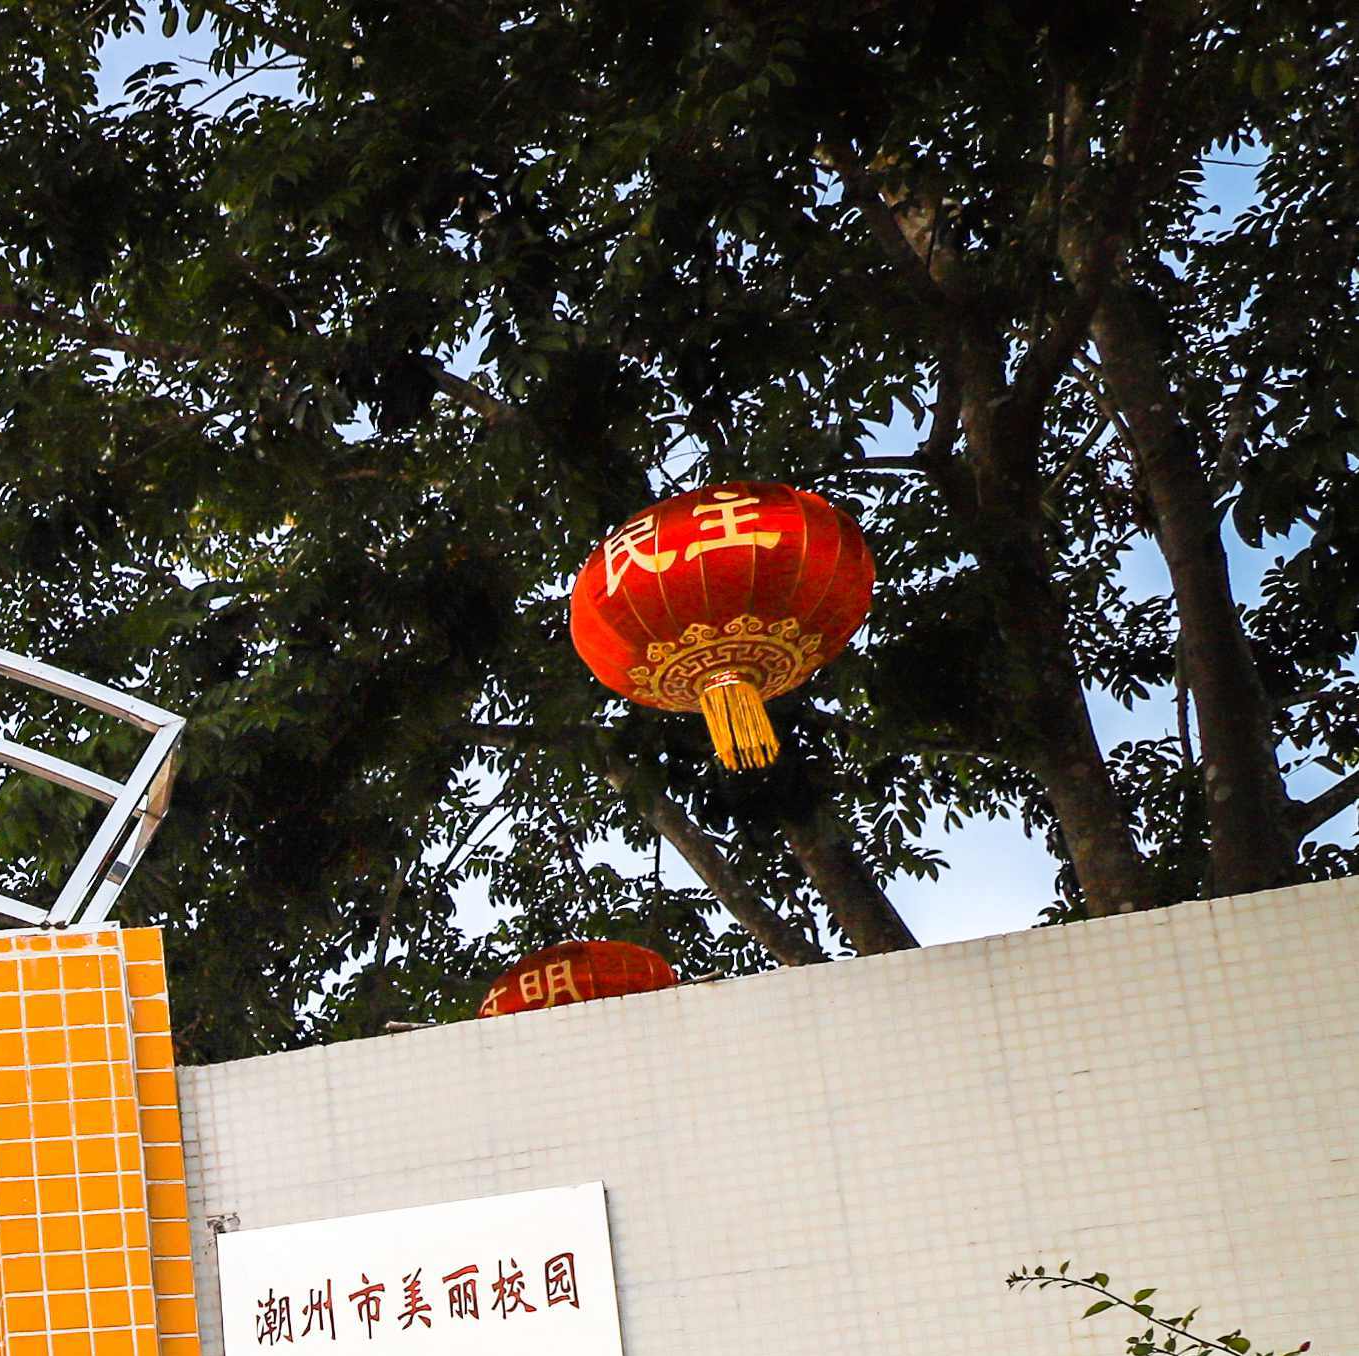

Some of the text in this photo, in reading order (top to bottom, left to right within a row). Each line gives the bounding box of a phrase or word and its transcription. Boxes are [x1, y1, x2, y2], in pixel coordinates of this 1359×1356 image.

[604, 491, 782, 598] 民主
[255, 1252, 581, 1345] 潮州市美丽校园
